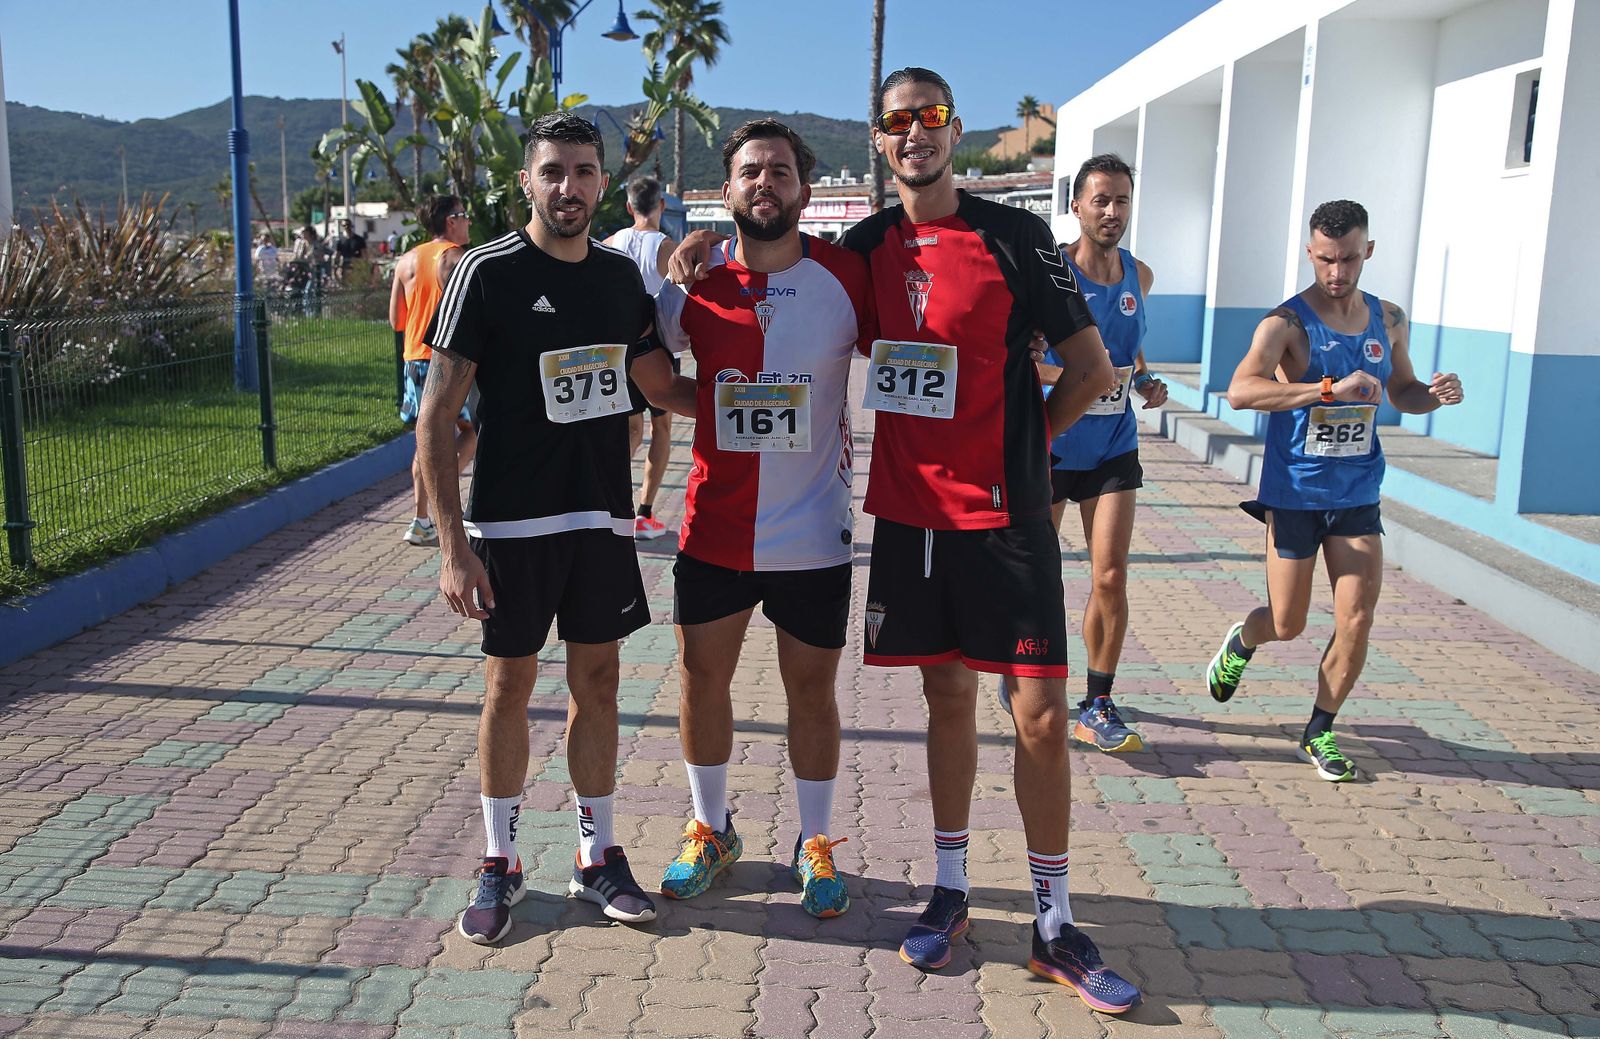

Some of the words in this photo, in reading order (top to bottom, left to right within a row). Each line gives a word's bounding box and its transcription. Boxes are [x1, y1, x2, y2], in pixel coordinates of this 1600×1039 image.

[739, 287, 797, 297] GIVOVA
[531, 306, 556, 314] adidas
[559, 366, 576, 375] CIUDAD
[576, 365, 583, 373] DE
[583, 361, 608, 372] ALGECIRAS
[553, 369, 618, 404] 379
[876, 365, 945, 398] 312
[726, 408, 796, 434] 161
[1316, 423, 1365, 443] 262
[578, 804, 596, 838] FILA
[1034, 879, 1053, 914] FILA
